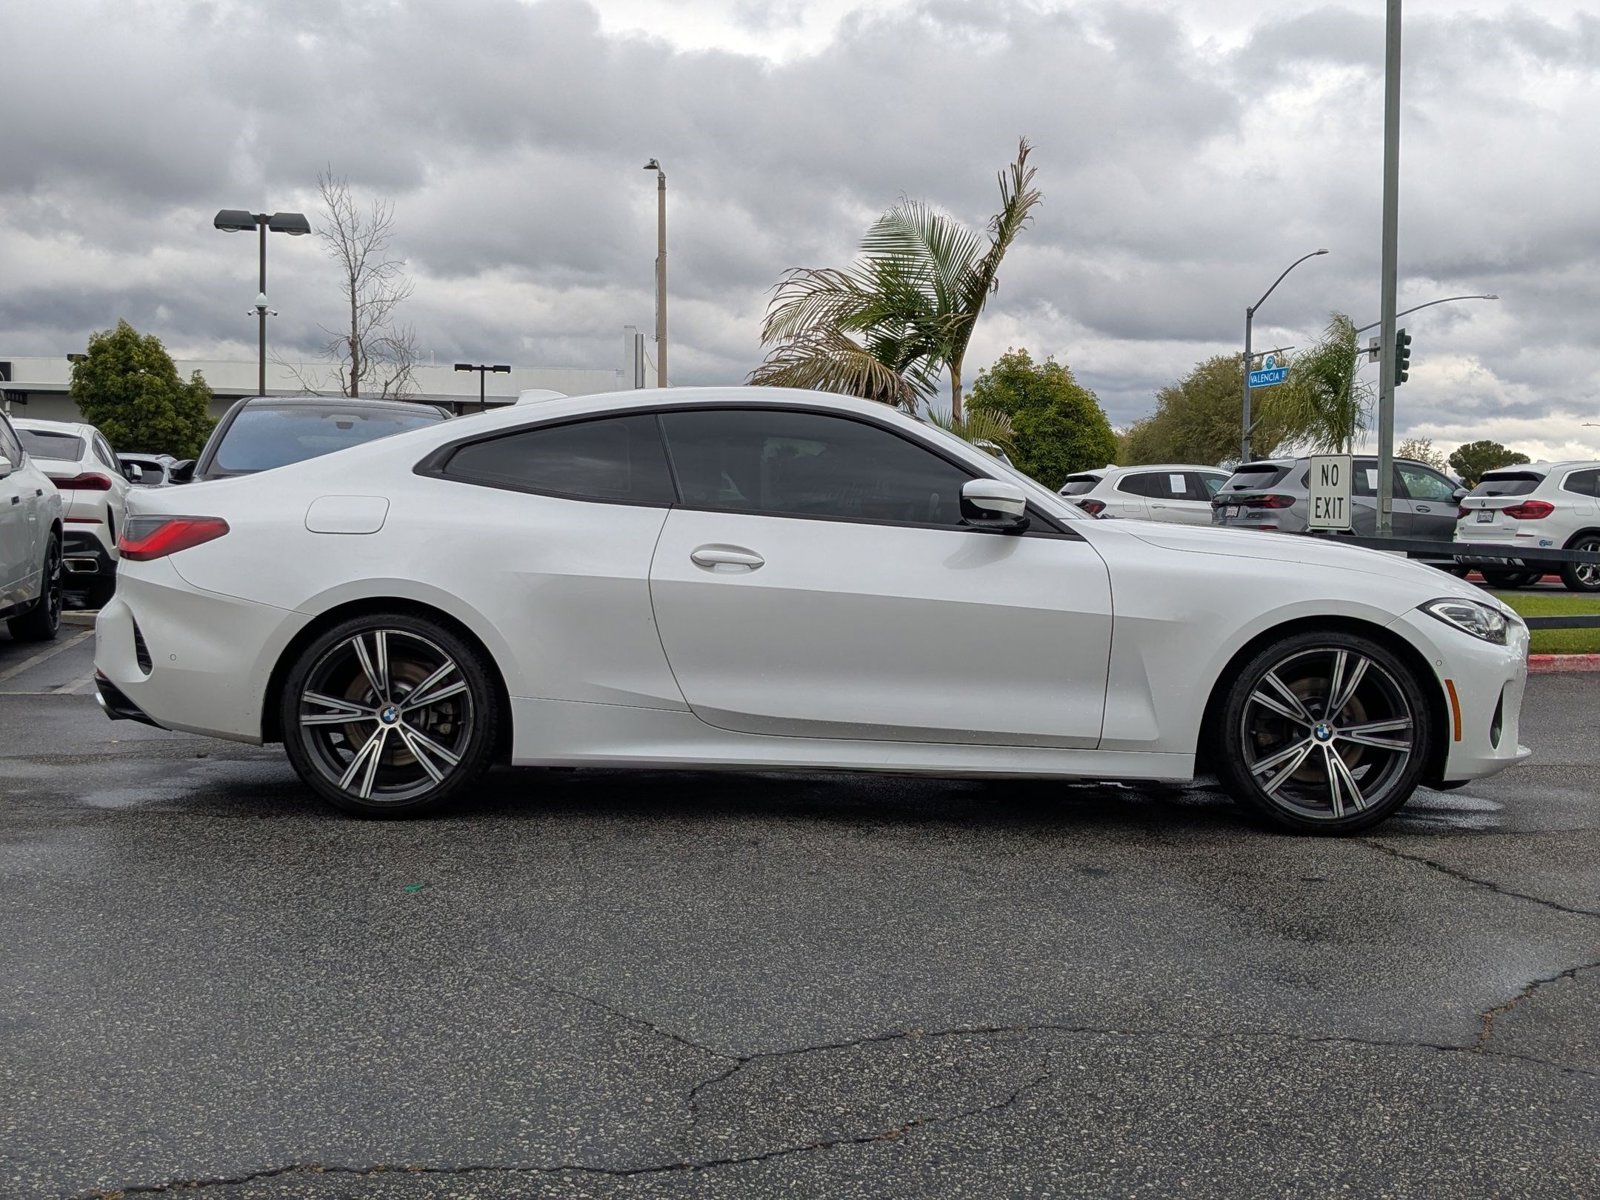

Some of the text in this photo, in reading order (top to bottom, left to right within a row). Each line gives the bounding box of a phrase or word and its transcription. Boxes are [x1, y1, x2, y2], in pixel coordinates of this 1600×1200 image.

[1251, 372, 1280, 384] VALENCIA
[1321, 464, 1339, 487] NO
[1315, 497, 1344, 519] EXIT
